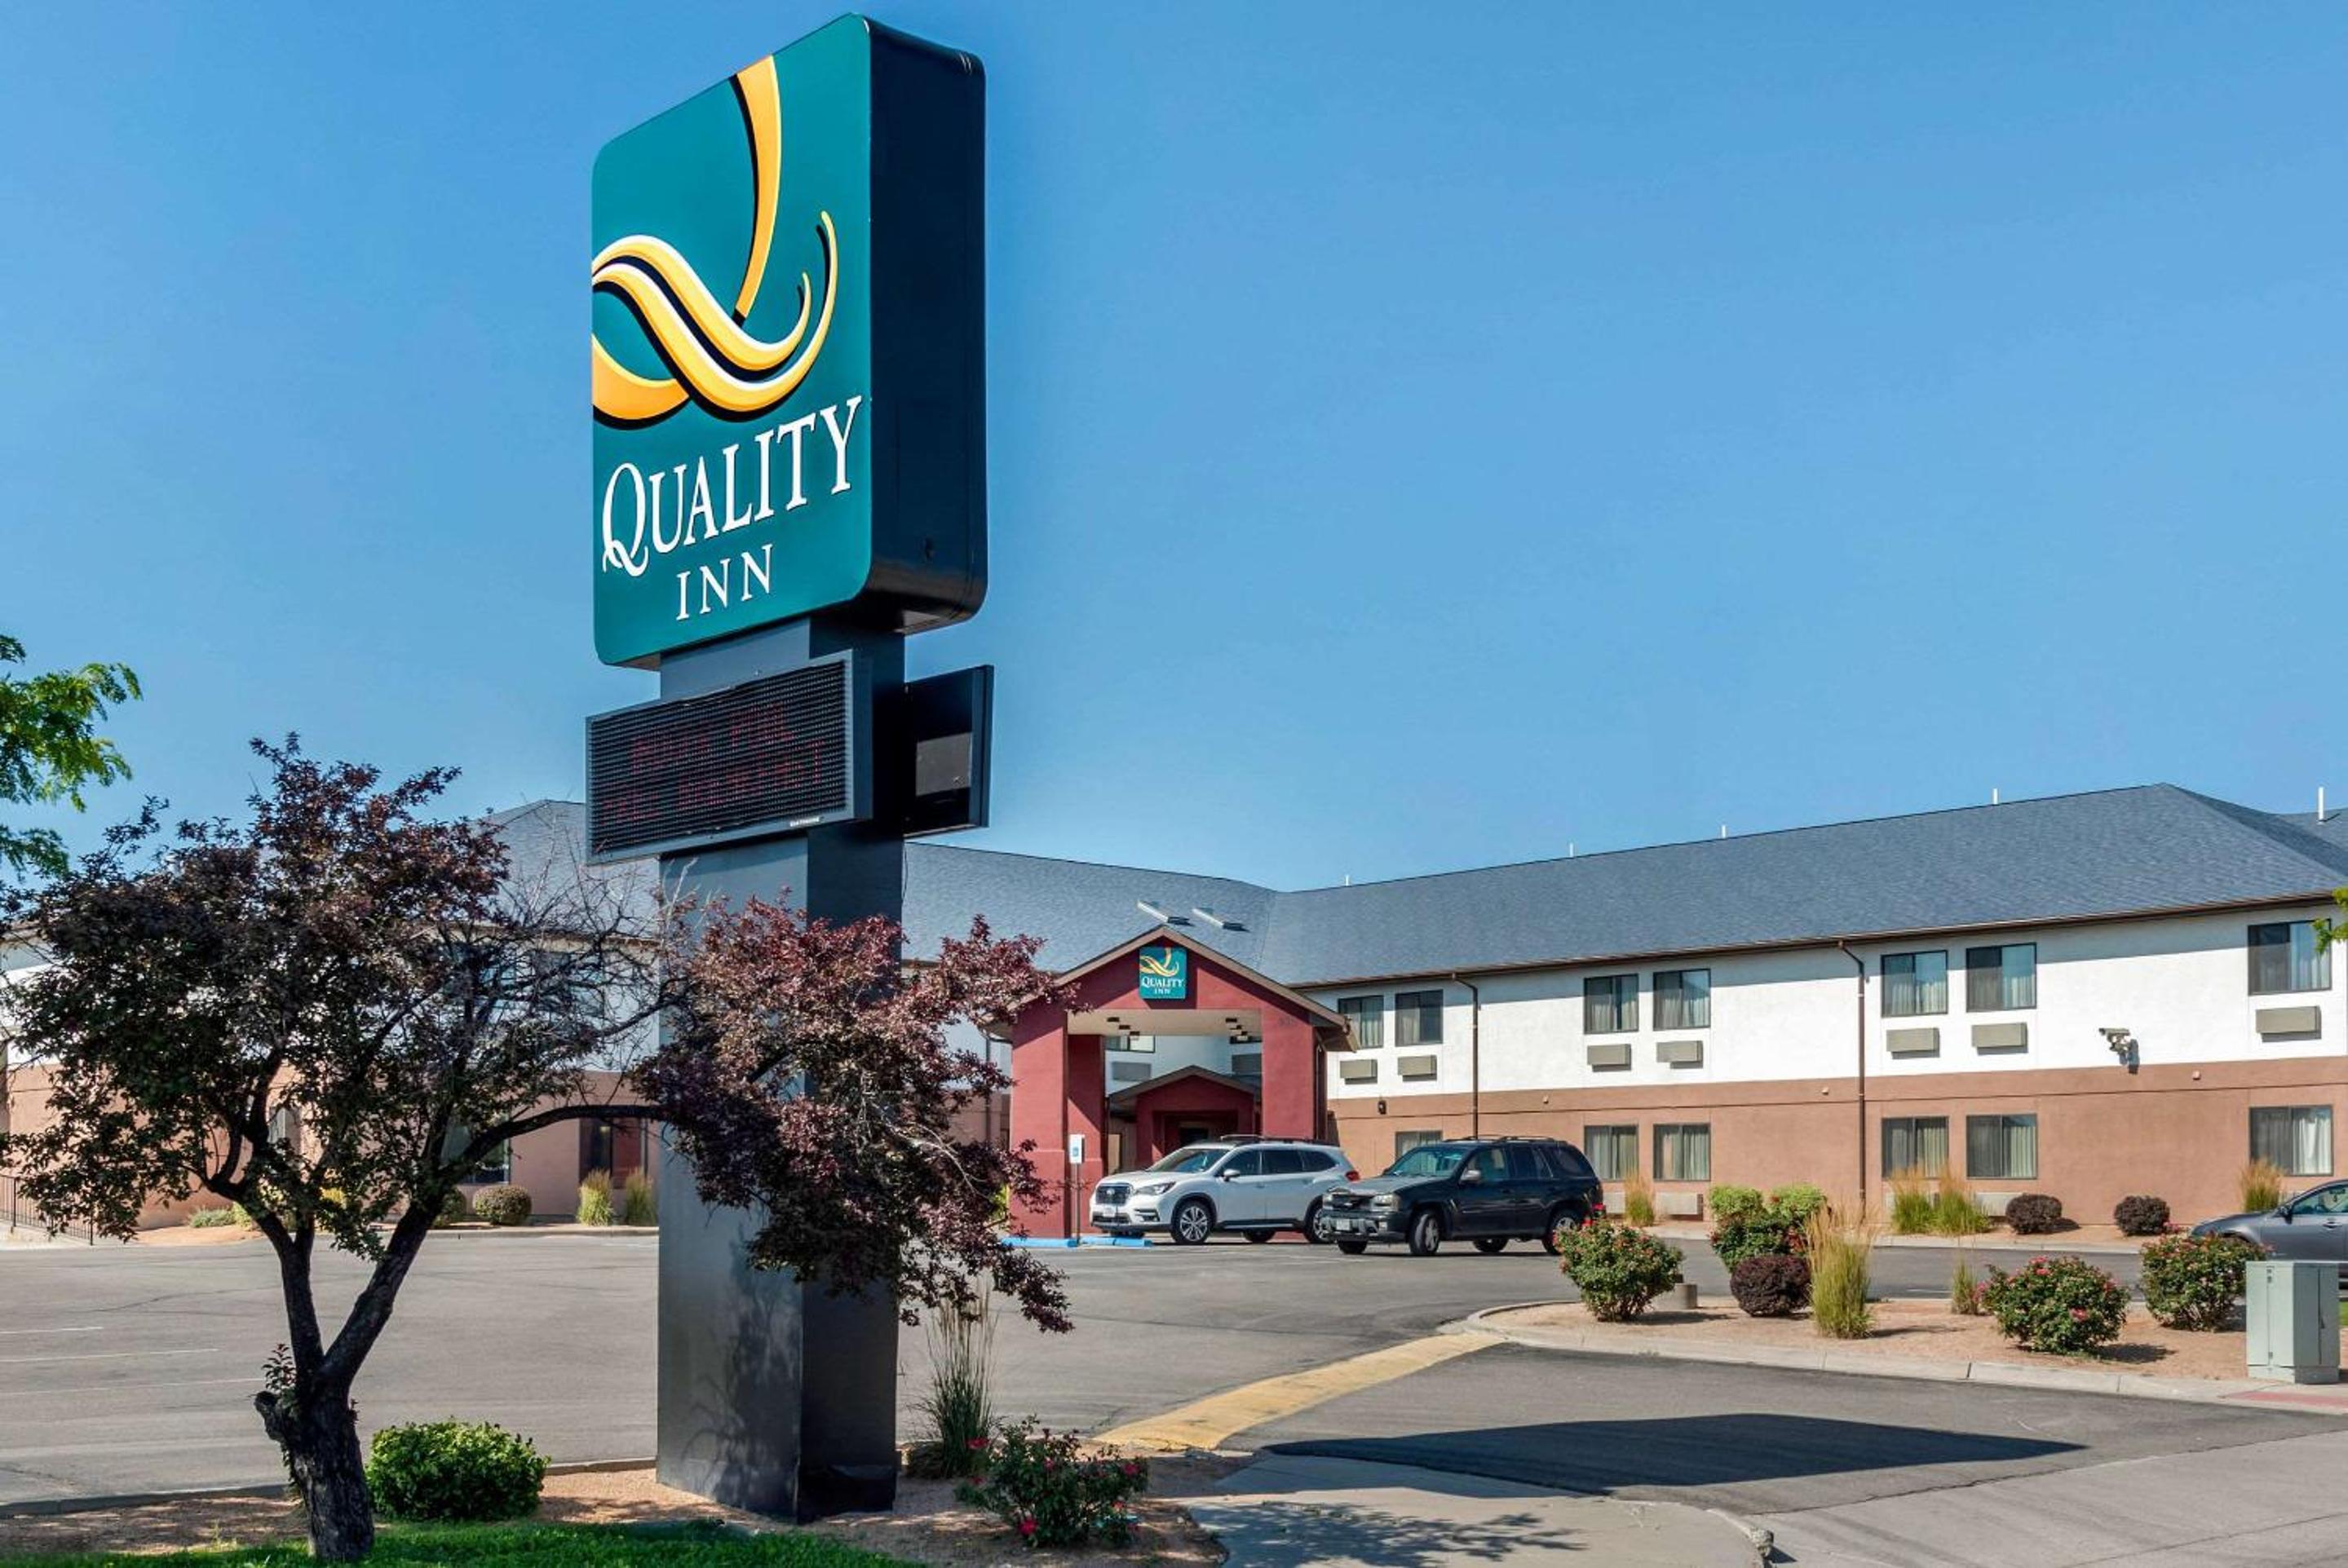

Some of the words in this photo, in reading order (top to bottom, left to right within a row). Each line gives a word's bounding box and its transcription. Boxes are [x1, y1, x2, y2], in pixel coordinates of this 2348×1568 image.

[602, 395, 862, 576] QUALITY
[676, 544, 773, 621] INN
[1142, 976, 1184, 987] QUALITY
